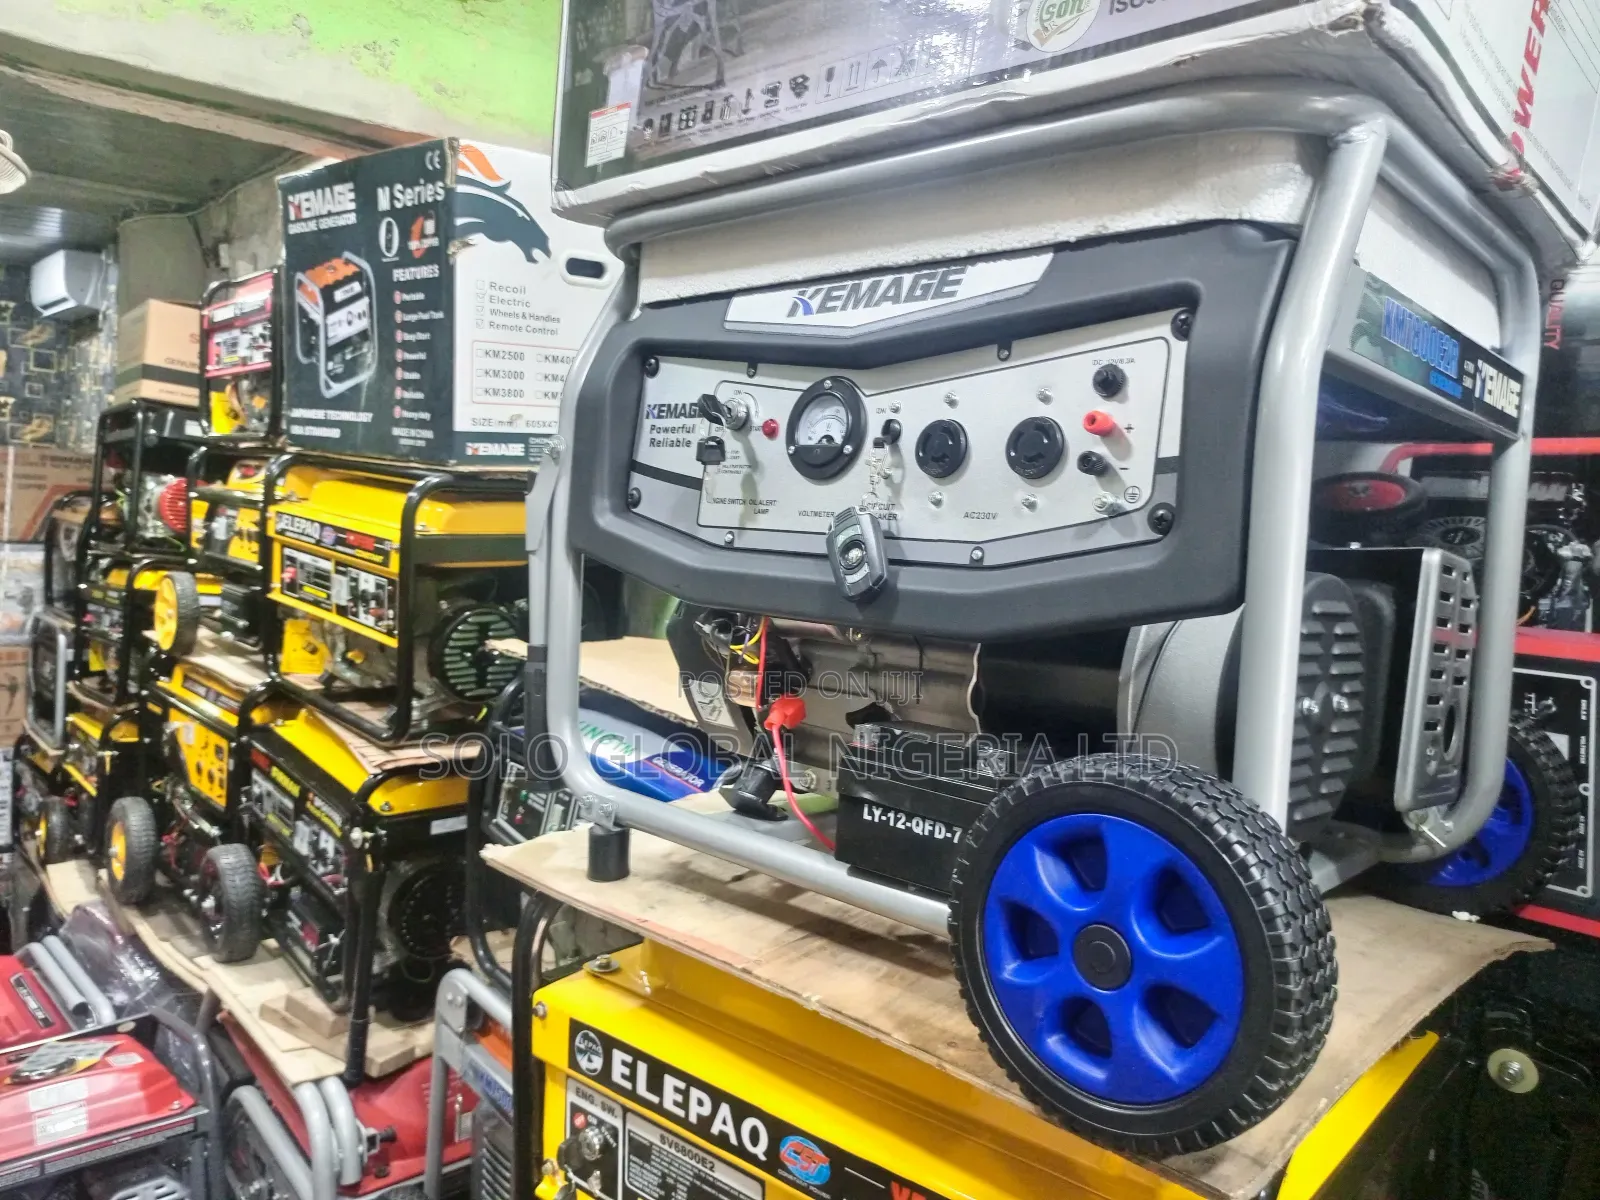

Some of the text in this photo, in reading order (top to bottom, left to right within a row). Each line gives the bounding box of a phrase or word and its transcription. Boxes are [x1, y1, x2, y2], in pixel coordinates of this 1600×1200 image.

[288, 182, 356, 220] KEMAGE
[376, 178, 445, 212] M Series
[392, 264, 439, 282] FEATURES
[489, 282, 526, 294] Recoil
[787, 265, 968, 318] KEMAGE
[489, 295, 530, 308] Electric
[490, 308, 560, 324] Wheels & Handles
[1544, 279, 1564, 350] QUALITY
[489, 321, 558, 336] Remote Control
[485, 350, 525, 362] KM2500
[484, 368, 525, 380] KM3000
[484, 388, 525, 398] KM3800
[1474, 359, 1522, 418] KEMAGE
[650, 424, 696, 434] Powerful
[465, 442, 526, 456] KEMAGE
[649, 438, 692, 448] Reliable
[798, 510, 836, 518] VOLTMETER
[963, 511, 999, 520] AC230V
[862, 803, 964, 844] LY-12-QFD-7
[575, 1086, 598, 1107] ENG.
[611, 1048, 770, 1161] ELEPAQ
[660, 1132, 716, 1172] SV6800E2
[780, 1141, 831, 1175] CST
